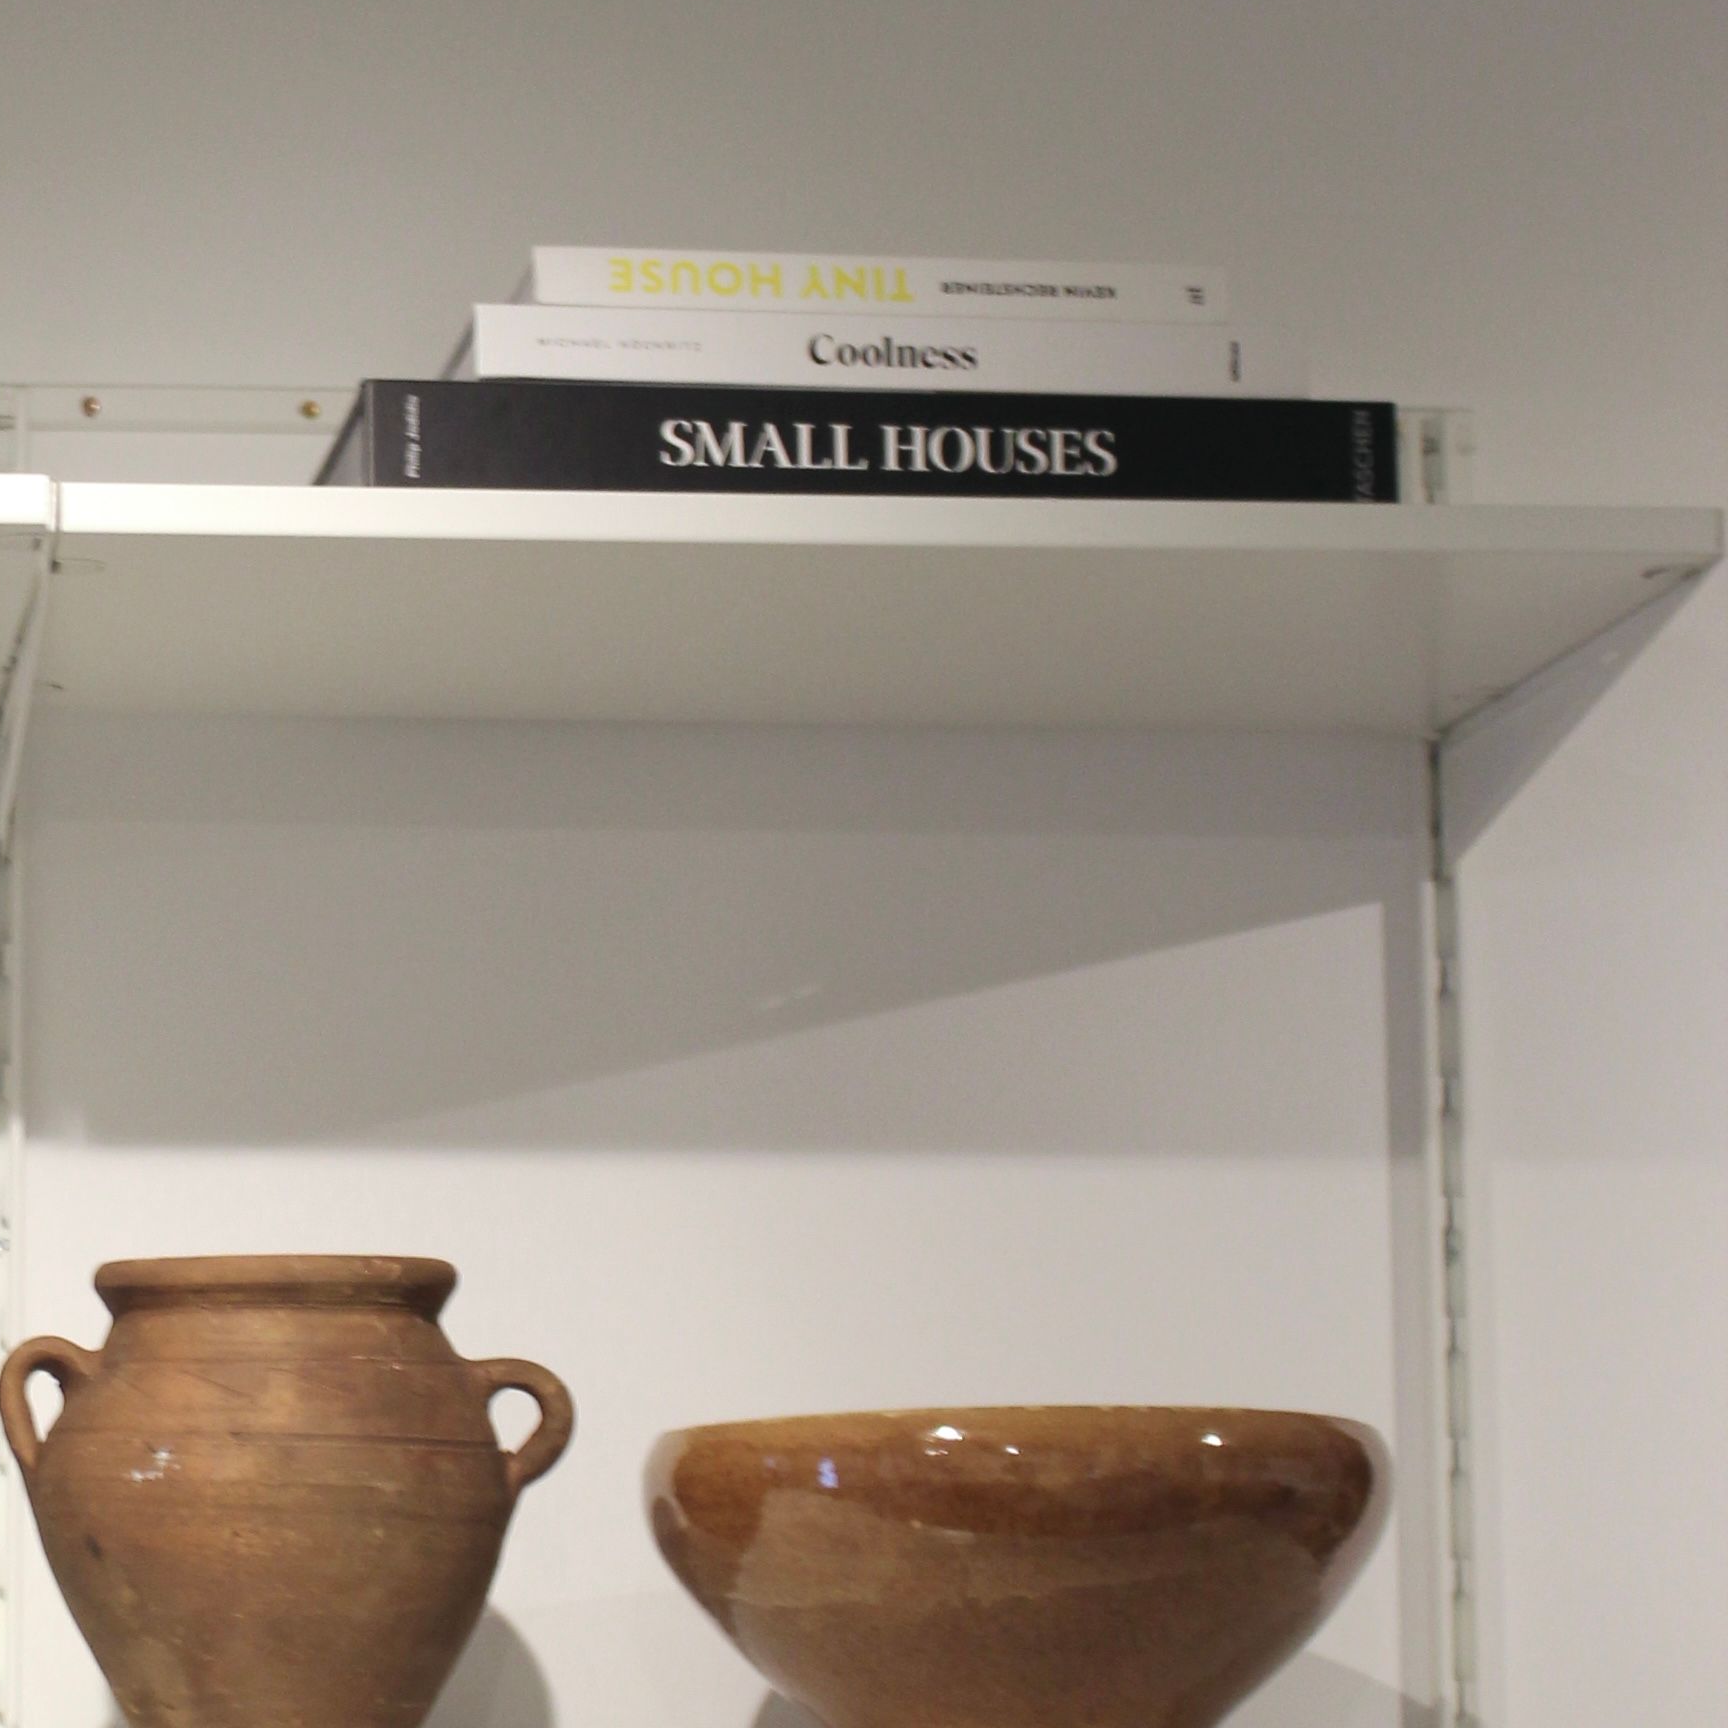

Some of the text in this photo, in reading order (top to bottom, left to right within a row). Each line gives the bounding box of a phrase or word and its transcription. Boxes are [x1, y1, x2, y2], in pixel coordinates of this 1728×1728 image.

[608, 256, 915, 303] TINY HOUSE
[808, 332, 979, 370] Coolness
[659, 419, 1118, 477] SMALL HOUSES
